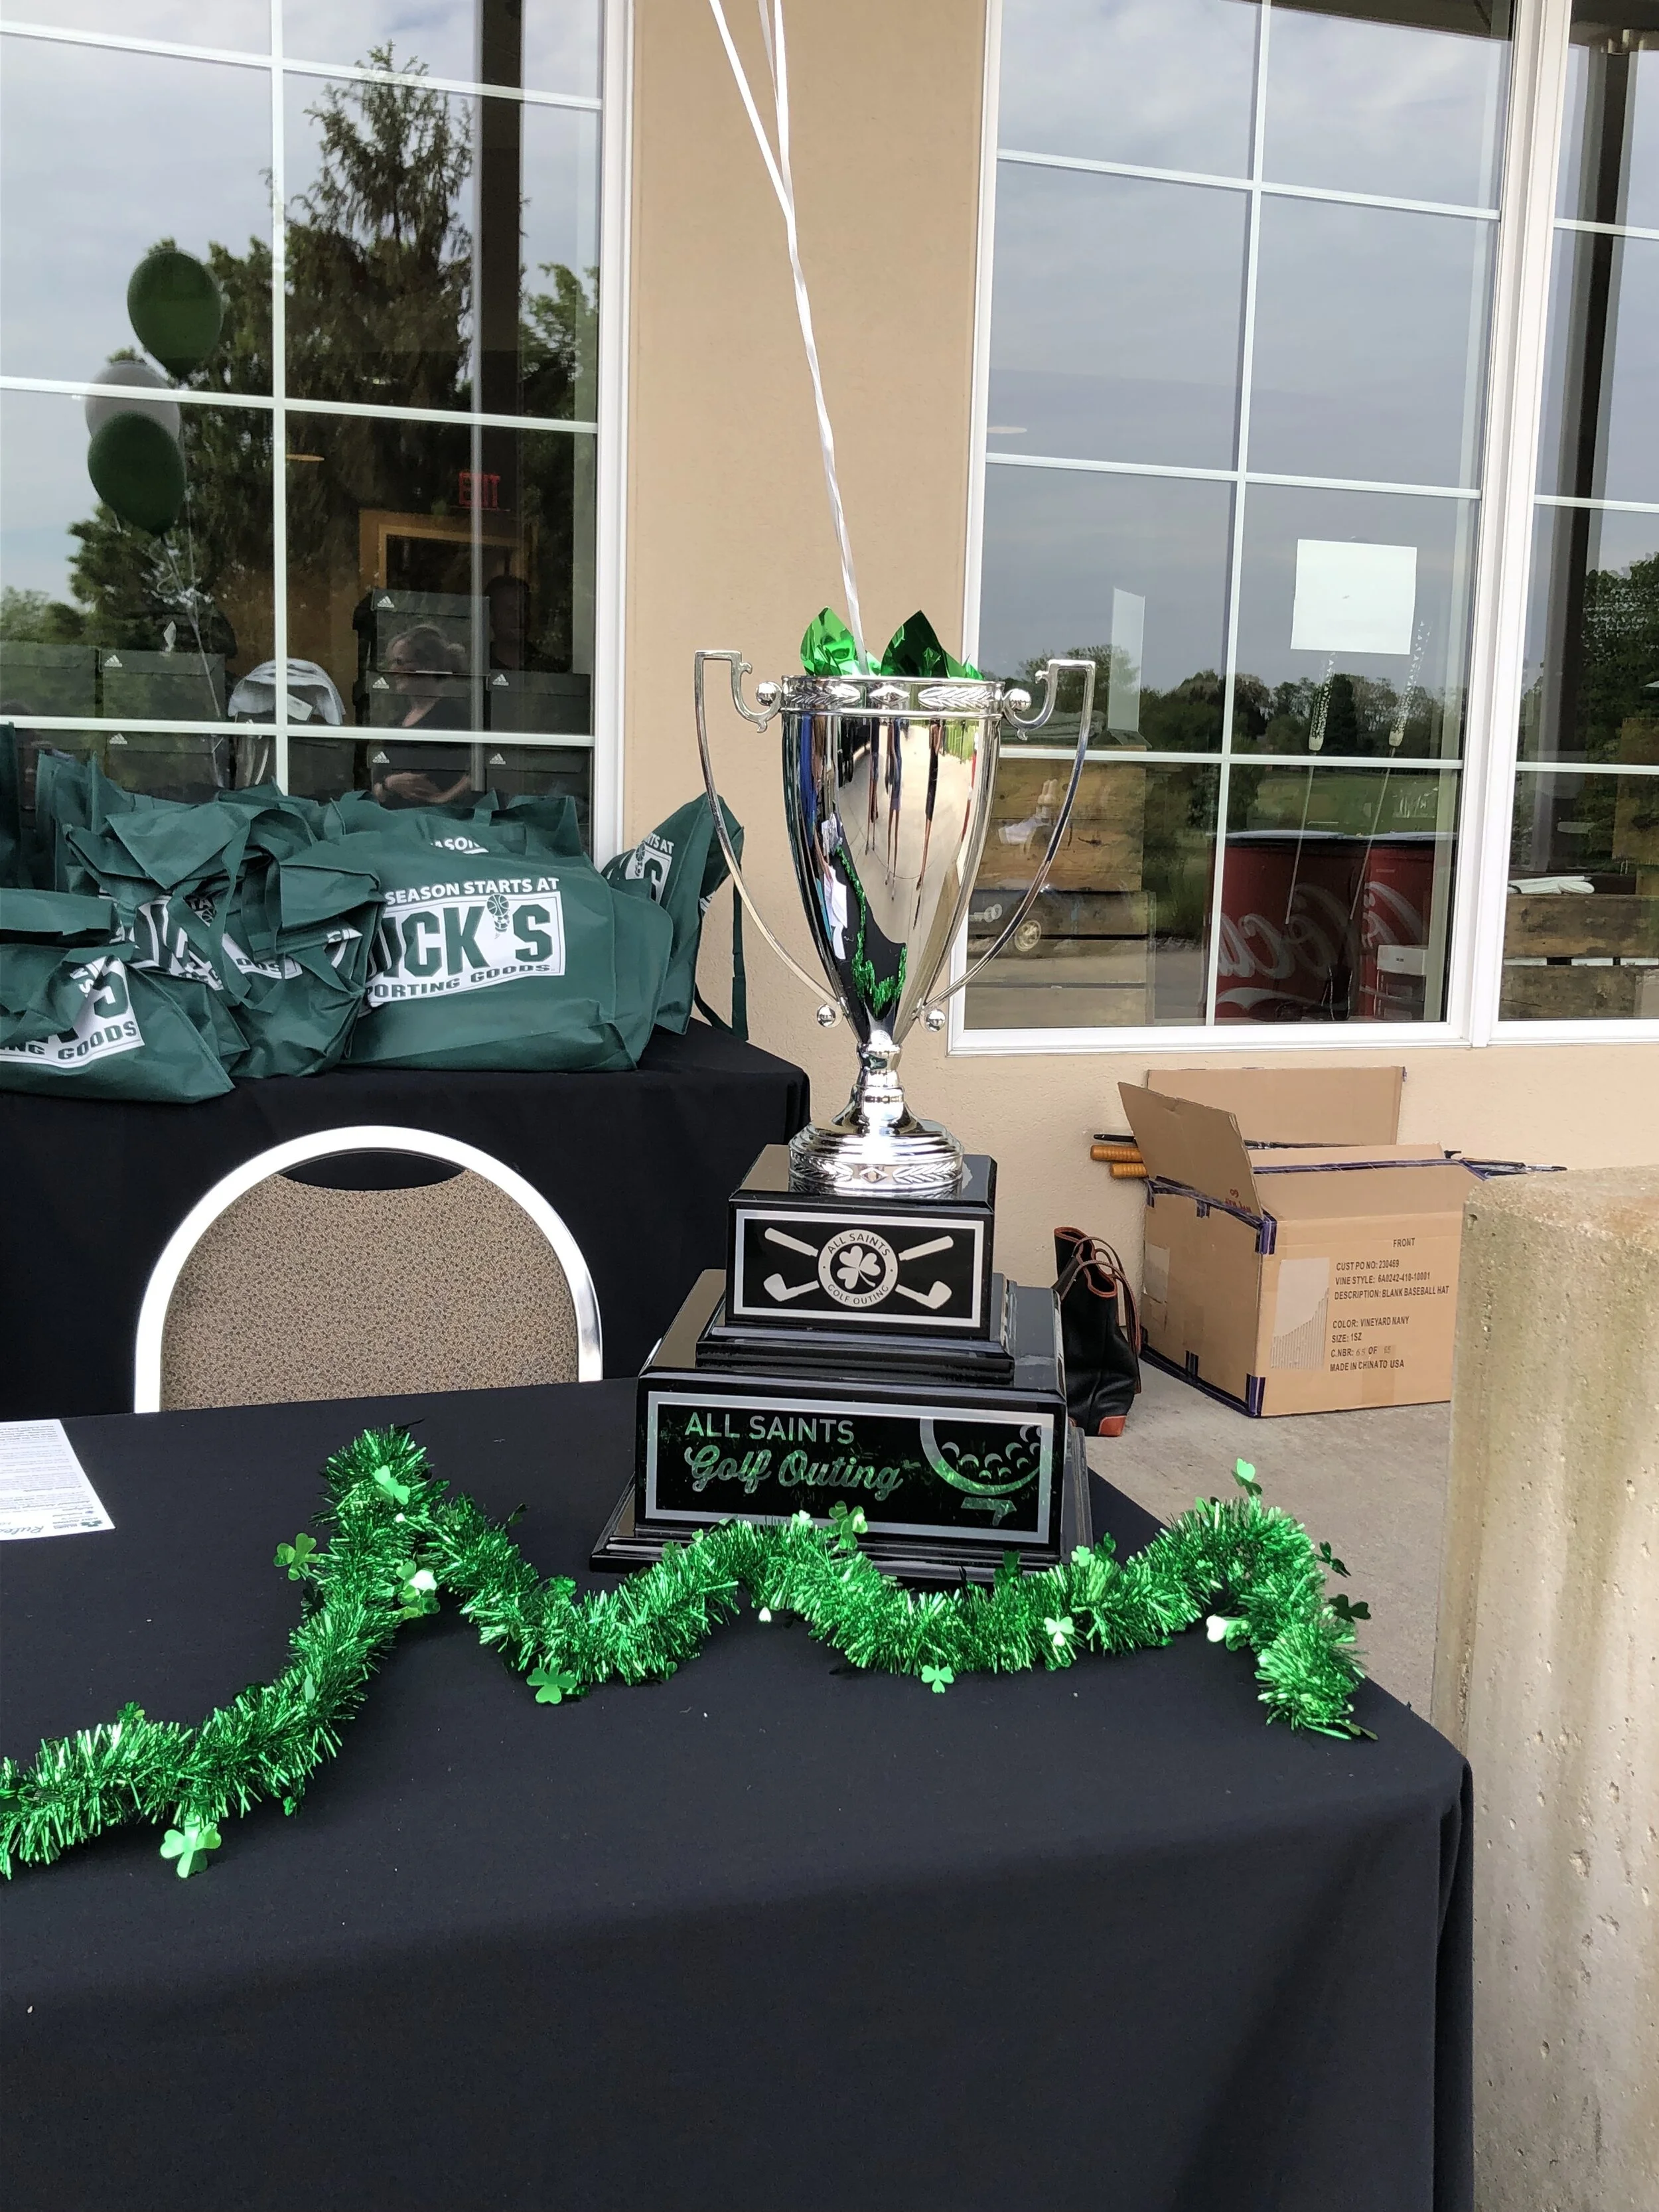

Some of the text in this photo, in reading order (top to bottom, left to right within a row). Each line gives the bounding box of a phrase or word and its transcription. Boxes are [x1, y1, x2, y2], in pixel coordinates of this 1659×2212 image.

[660, 839, 675, 854] AT
[384, 877, 559, 905] SEASON STARTS AT
[369, 903, 553, 978] ICK'S
[365, 964, 551, 998] PORTING GOODS
[58, 1020, 137, 1060] GOODS
[827, 1233, 891, 1256] ALL SAINTS
[1393, 1238, 1415, 1248] FRONT
[1336, 1262, 1354, 1271] CUST
[1355, 1261, 1365, 1270] PO
[1366, 1260, 1378, 1270] NO:
[1335, 1276, 1351, 1286] VINE
[1352, 1275, 1376, 1285] STYLE:
[828, 1284, 889, 1305] GOLF OUTING
[1334, 1285, 1449, 1300] DESCRIPTION: BLANK BASEBALL HAT
[1333, 1319, 1358, 1329] COLOR:
[1360, 1317, 1391, 1327] VINEYARD
[1331, 1332, 1362, 1343] SIZE: 1SZ
[1368, 1346, 1378, 1355] OF
[1330, 1362, 1349, 1372] MADE
[1358, 1360, 1378, 1370] CHINA
[1379, 1360, 1388, 1368] TO
[1390, 1359, 1404, 1368] USA
[684, 1412, 854, 1444] ALL SAINTS
[684, 1444, 904, 1501] Golf Outing
